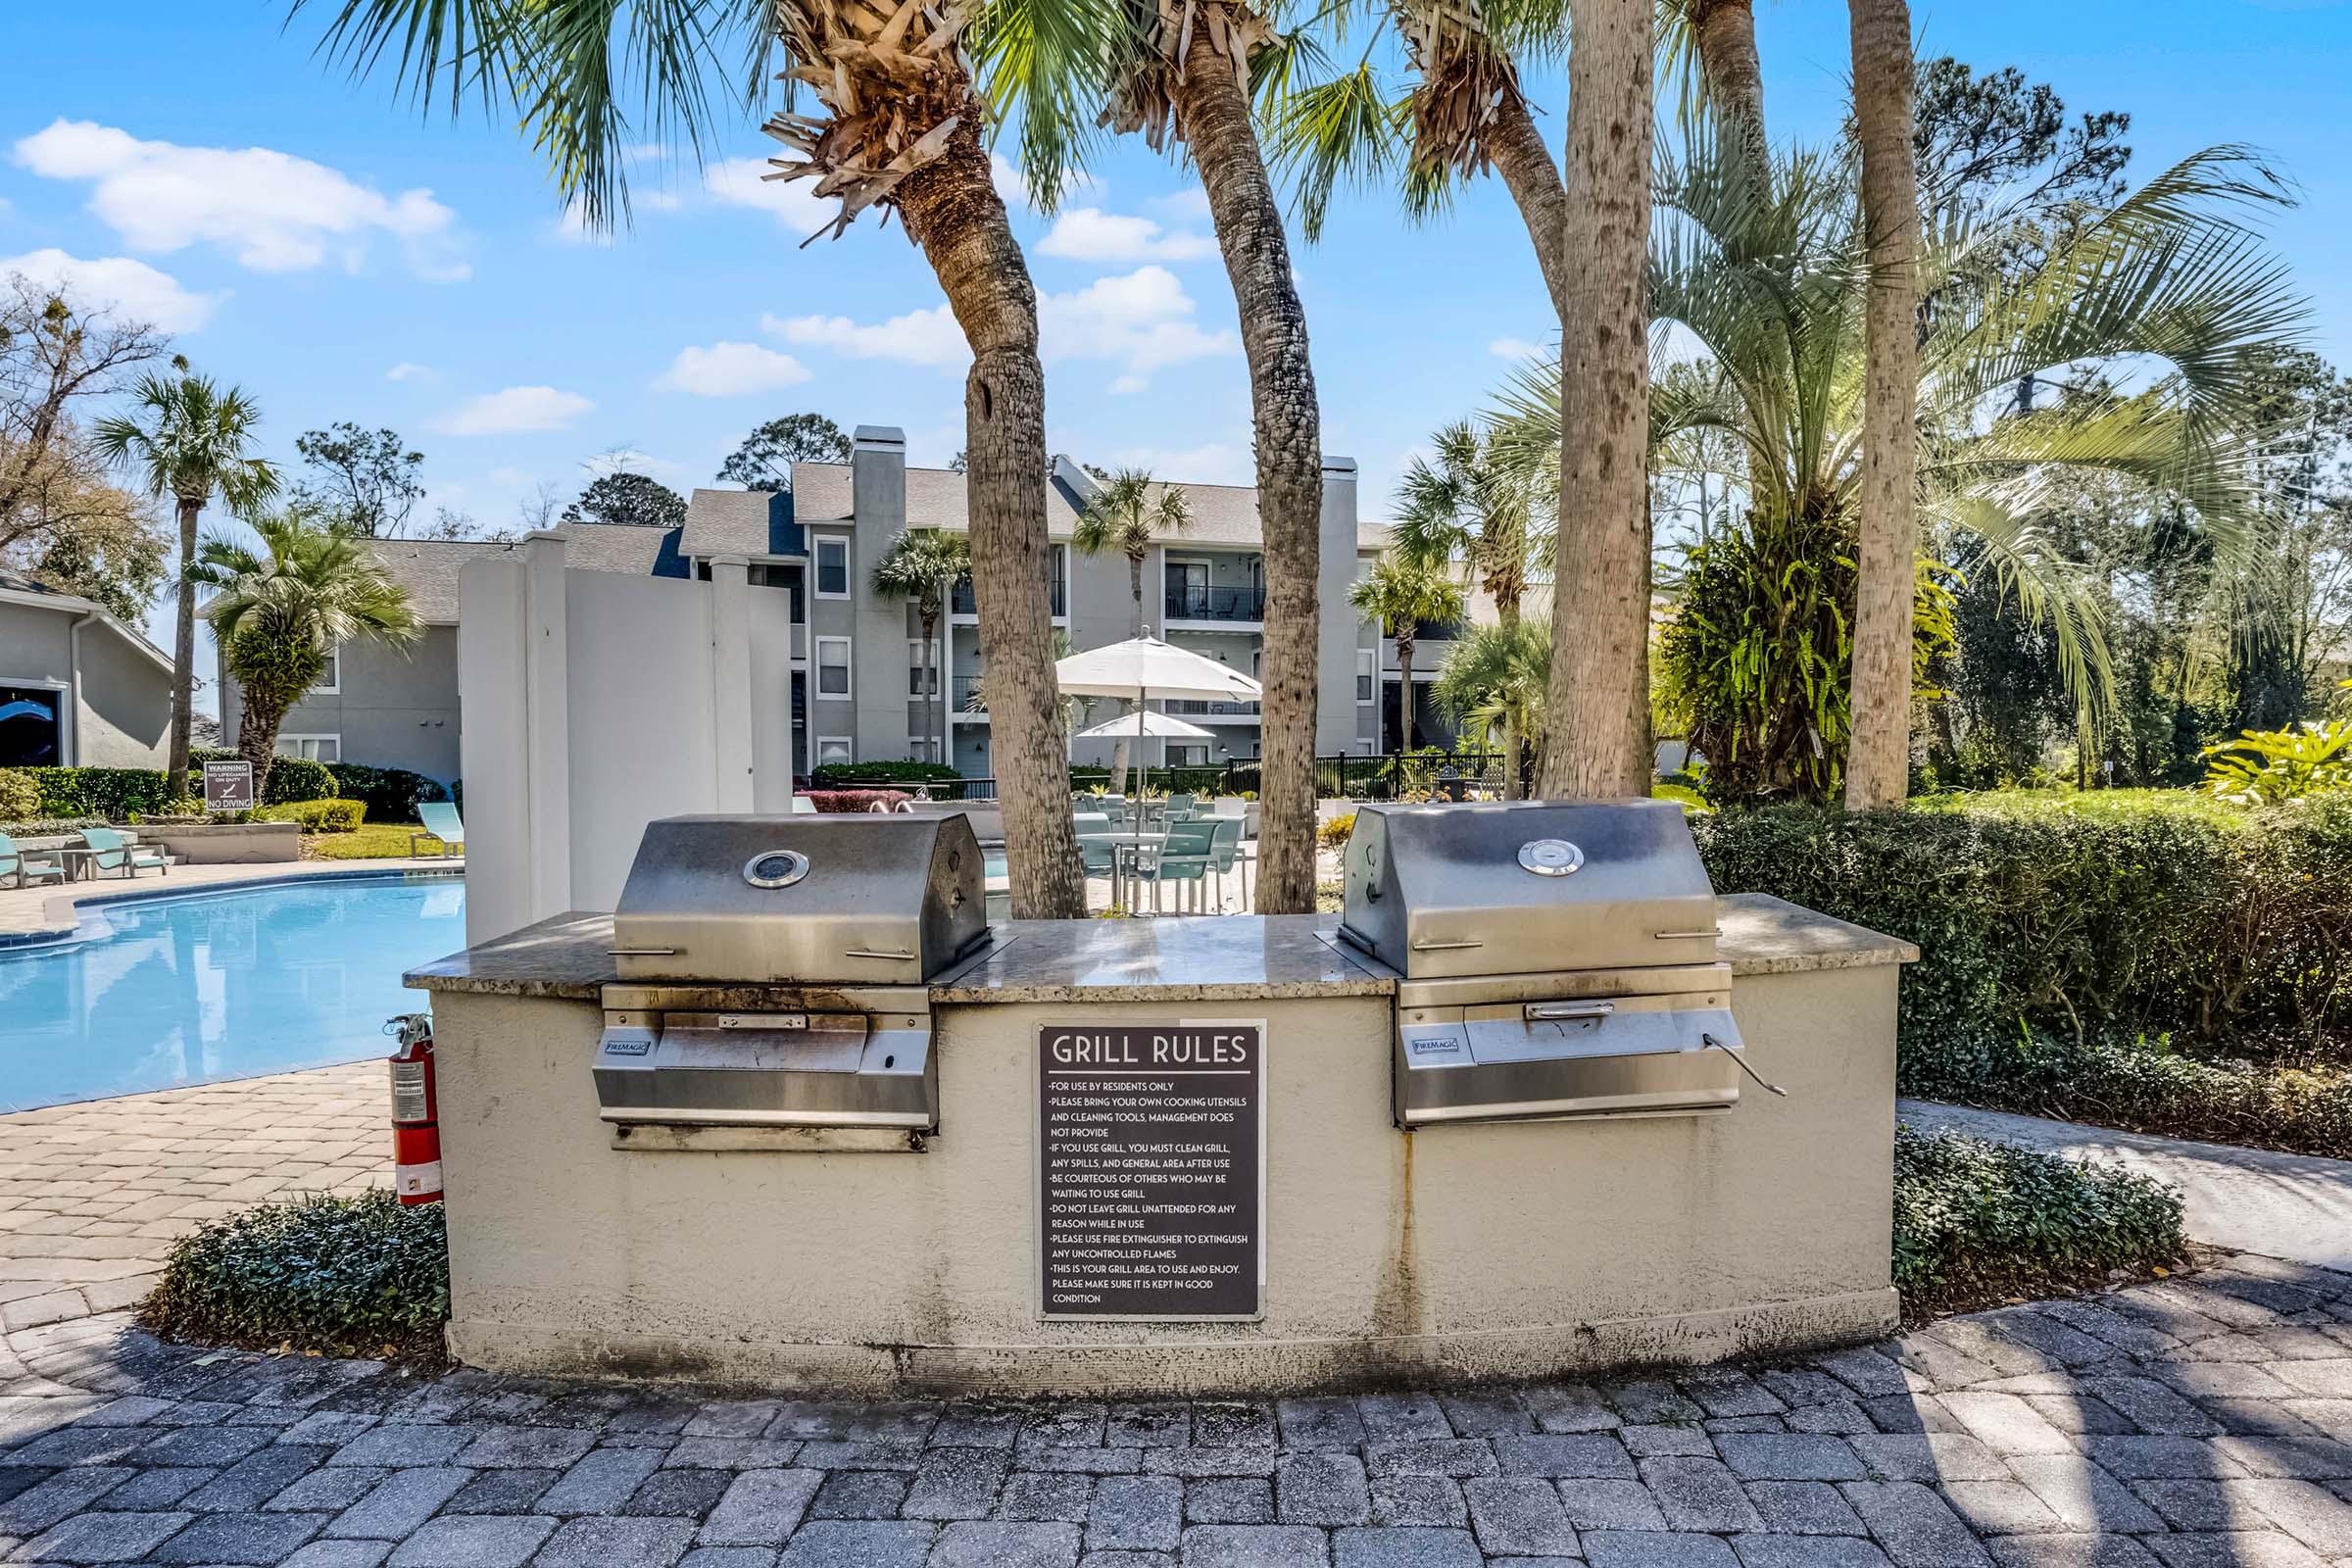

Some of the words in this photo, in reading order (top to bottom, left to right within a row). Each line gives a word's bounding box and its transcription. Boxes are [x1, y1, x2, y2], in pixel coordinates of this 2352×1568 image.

[209, 800, 221, 808] NO
[222, 799, 251, 808] DIVING
[1053, 1035, 1139, 1063] GRILL
[1153, 1035, 1247, 1063] RULES
[1071, 1082, 1087, 1091] USE
[1089, 1082, 1101, 1091] BY
[1102, 1082, 1148, 1091] RESIDENTS
[1149, 1082, 1174, 1091] ONLY
[1084, 1098, 1109, 1106] BRING
[1111, 1098, 1137, 1106] YOUR
[1138, 1098, 1161, 1106] OWN
[1163, 1098, 1205, 1106] COOKING
[1207, 1098, 1247, 1106] UTENSILS
[1051, 1113, 1069, 1122] AND
[1070, 1113, 1113, 1122] CLEANING
[1114, 1113, 1148, 1123] TOOLS,
[1149, 1113, 1207, 1122] MANAGEMENT
[1210, 1113, 1234, 1122] DOES
[1051, 1128, 1069, 1138] NOT
[1071, 1128, 1108, 1138] PROVIDE
[1061, 1144, 1081, 1152] YOU
[1082, 1144, 1099, 1152] USE
[1101, 1144, 1126, 1152] GRILL,
[1128, 1144, 1149, 1152] YOU
[1150, 1144, 1173, 1152] MUST
[1175, 1144, 1202, 1152] CLEAN
[1204, 1144, 1231, 1153] GRILL,
[1051, 1159, 1069, 1168] ANY
[1071, 1159, 1101, 1168] SPILLS,
[1102, 1159, 1121, 1168] AND
[1122, 1159, 1161, 1168] GENERAL
[1162, 1159, 1184, 1168] AREA
[1186, 1159, 1212, 1168] AFTER
[1213, 1159, 1230, 1168] USE
[1064, 1174, 1117, 1183] COURTEOUS
[1118, 1174, 1132, 1183] OF
[1134, 1174, 1168, 1183] OTHERS
[1169, 1174, 1193, 1183] WHO
[1195, 1174, 1213, 1183] MAY
[1215, 1174, 1227, 1183] BE
[1052, 1189, 1087, 1198] WAITING
[1089, 1189, 1102, 1198] TO
[1103, 1189, 1119, 1198] USE
[1121, 1189, 1145, 1198] GRILL
[1068, 1204, 1087, 1213] NOT
[1089, 1204, 1114, 1213] LEAVE
[1116, 1204, 1140, 1213] GRILL
[1142, 1204, 1197, 1213] UNATTENDED
[1198, 1204, 1216, 1213] FOR
[1218, 1204, 1236, 1213] ANY
[1052, 1219, 1087, 1228] REASON
[1089, 1219, 1116, 1228] WHILE
[1117, 1219, 1126, 1228] IN
[1128, 1219, 1145, 1228] USE
[1085, 1235, 1102, 1244] USE
[1102, 1235, 1121, 1244] FIRE
[1122, 1235, 1182, 1244] EXTINGUISHER
[1184, 1235, 1197, 1244] TO
[1198, 1235, 1248, 1244] EXTINGUISH
[1052, 1250, 1070, 1258] ANY
[1071, 1250, 1142, 1258] UNCONTROLLED
[1143, 1250, 1176, 1258] FLAMES
[1072, 1264, 1080, 1273] IS
[1082, 1264, 1106, 1273] YOUR
[1107, 1264, 1132, 1273] GRILL
[1134, 1264, 1155, 1273] AREA
[1157, 1264, 1170, 1273] TO
[1171, 1264, 1188, 1273] USE
[1190, 1264, 1207, 1273] AND
[1209, 1264, 1241, 1273] ENJOY.
[1053, 1280, 1083, 1289] PLEASE
[1085, 1280, 1109, 1289] MAKE
[1110, 1280, 1132, 1289] SURE
[1134, 1280, 1141, 1289] IT
[1143, 1280, 1151, 1289] IS
[1152, 1280, 1173, 1289] KEPT
[1174, 1280, 1183, 1289] IN
[1185, 1280, 1213, 1289] GOOD
[1053, 1295, 1101, 1303] CONDITION
